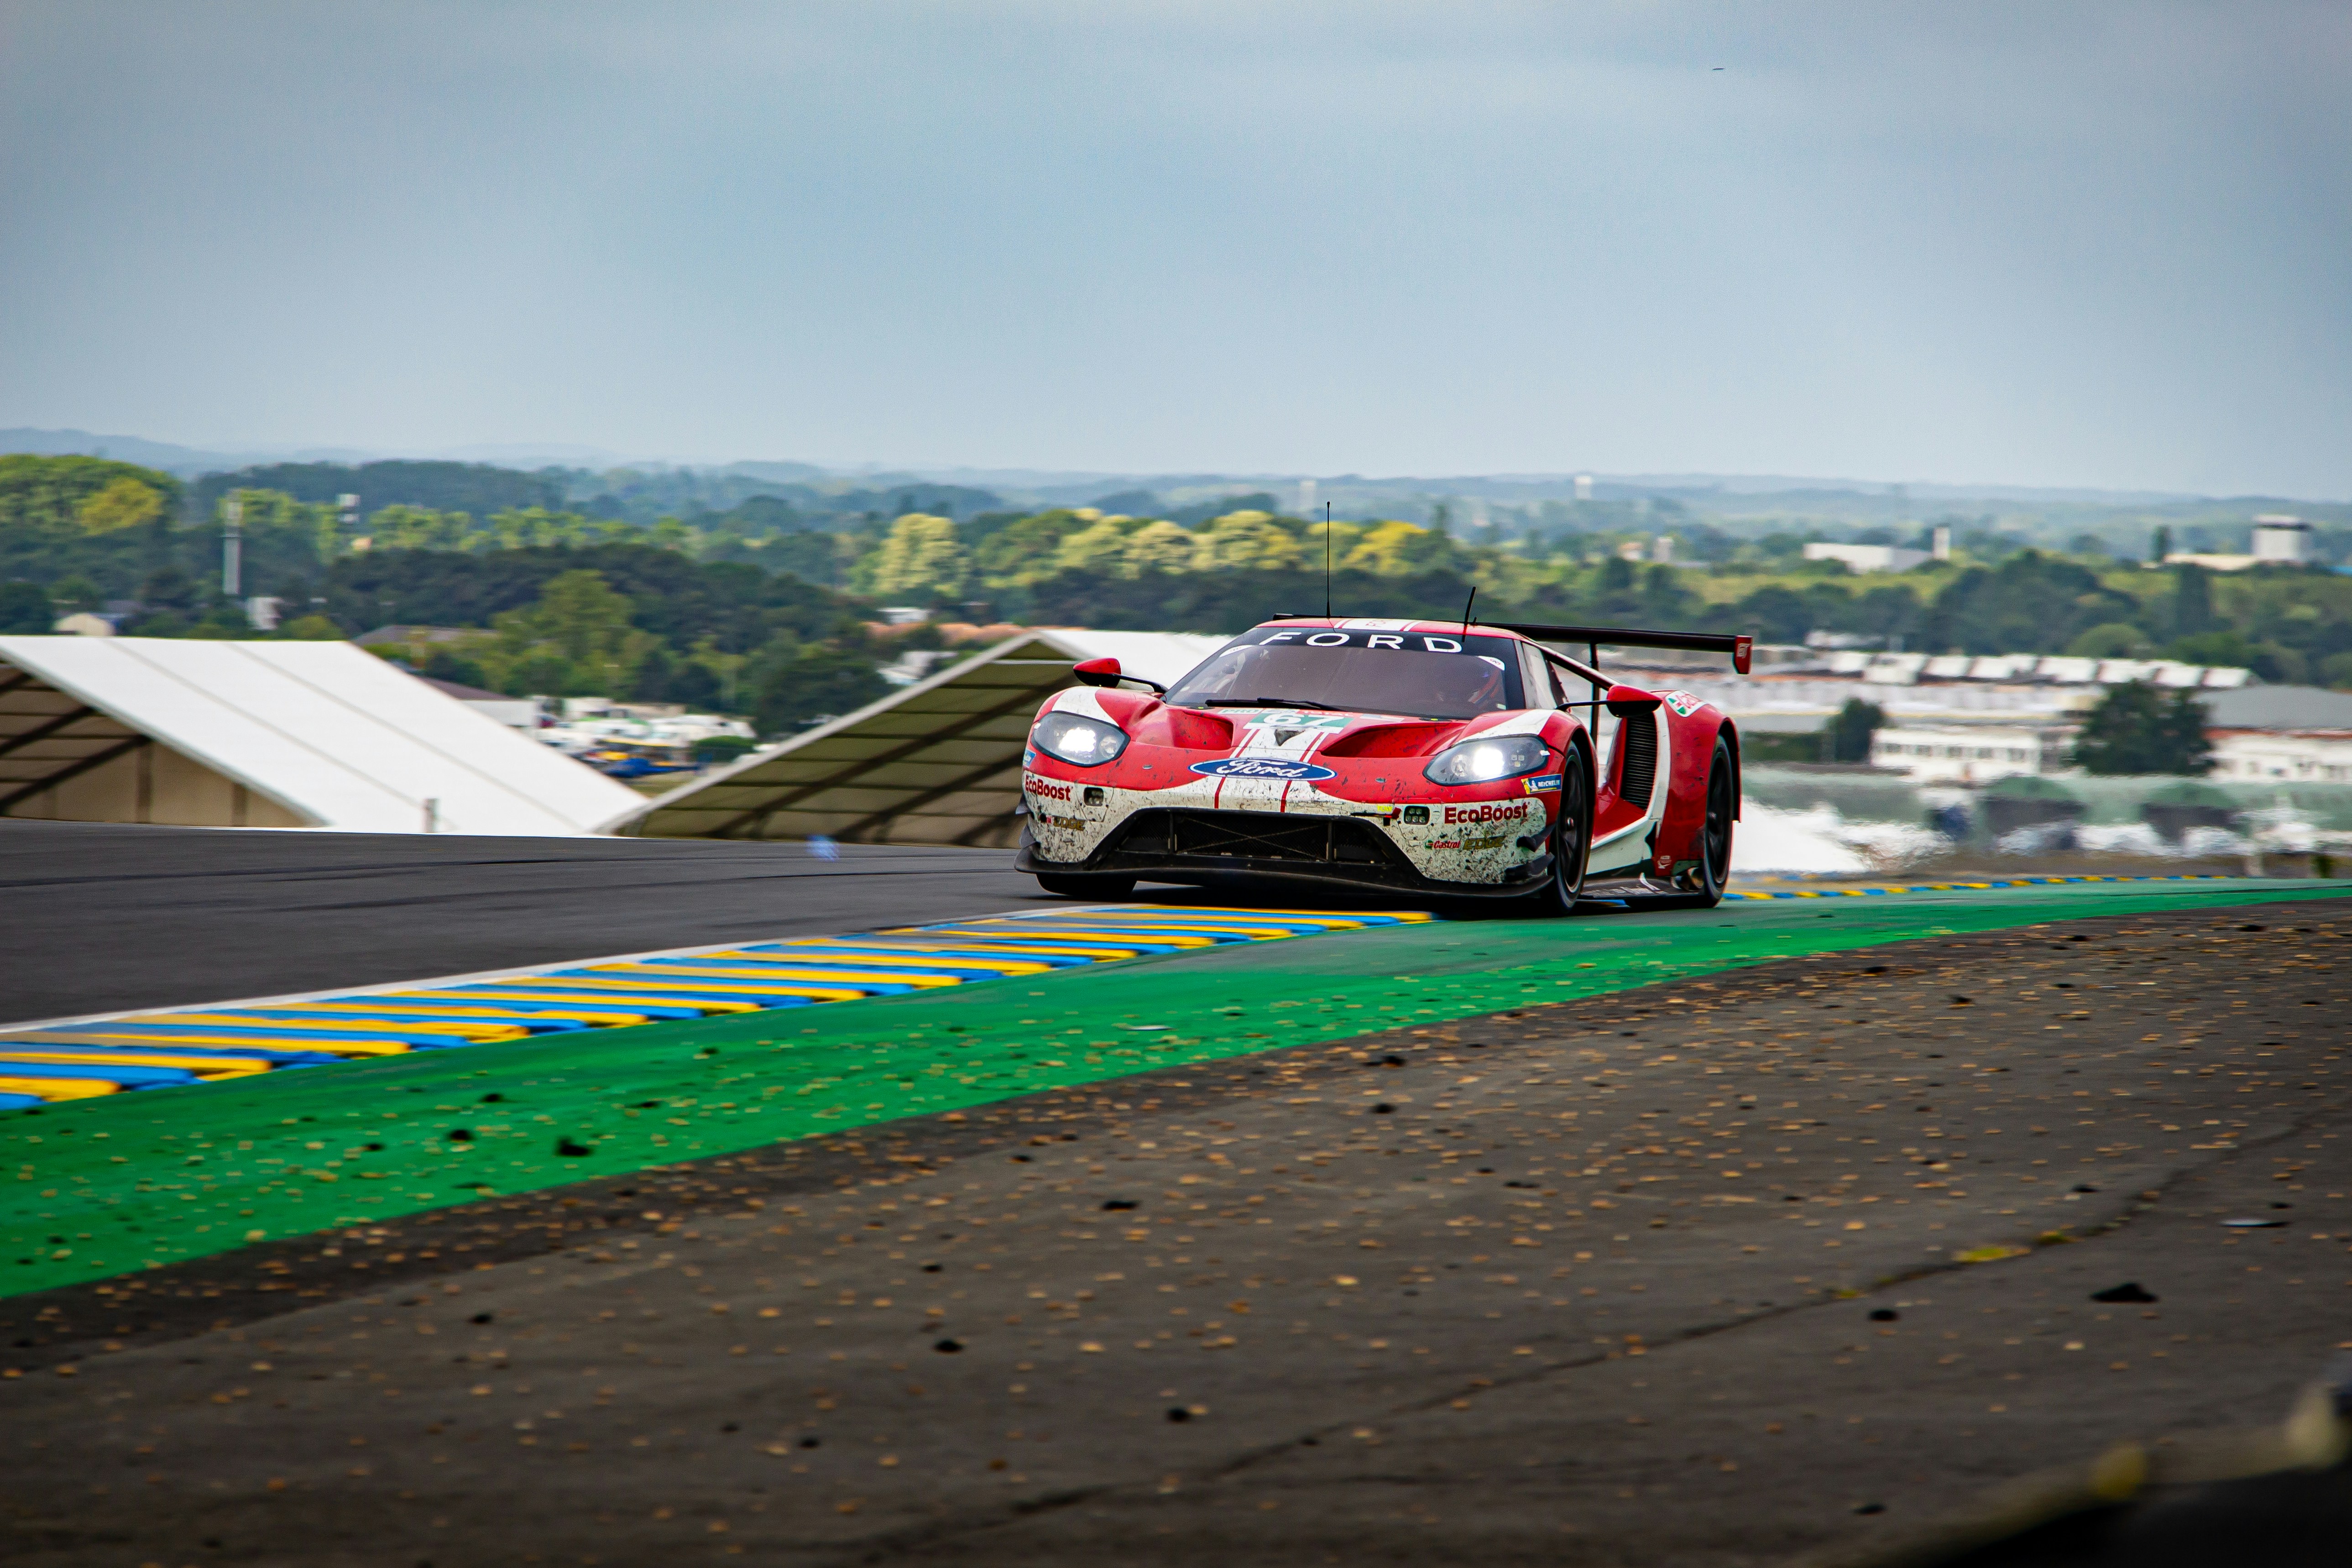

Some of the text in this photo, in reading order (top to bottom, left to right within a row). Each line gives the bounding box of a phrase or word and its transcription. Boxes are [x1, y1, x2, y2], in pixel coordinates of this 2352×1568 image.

[1259, 632, 1463, 653] FORD
[1264, 713, 1344, 726] 67
[1216, 759, 1309, 777] Ford
[1025, 774, 1071, 802] EcoBoost
[1444, 802, 1528, 824] EcoBoost
[1433, 840, 1460, 849] Castrol
